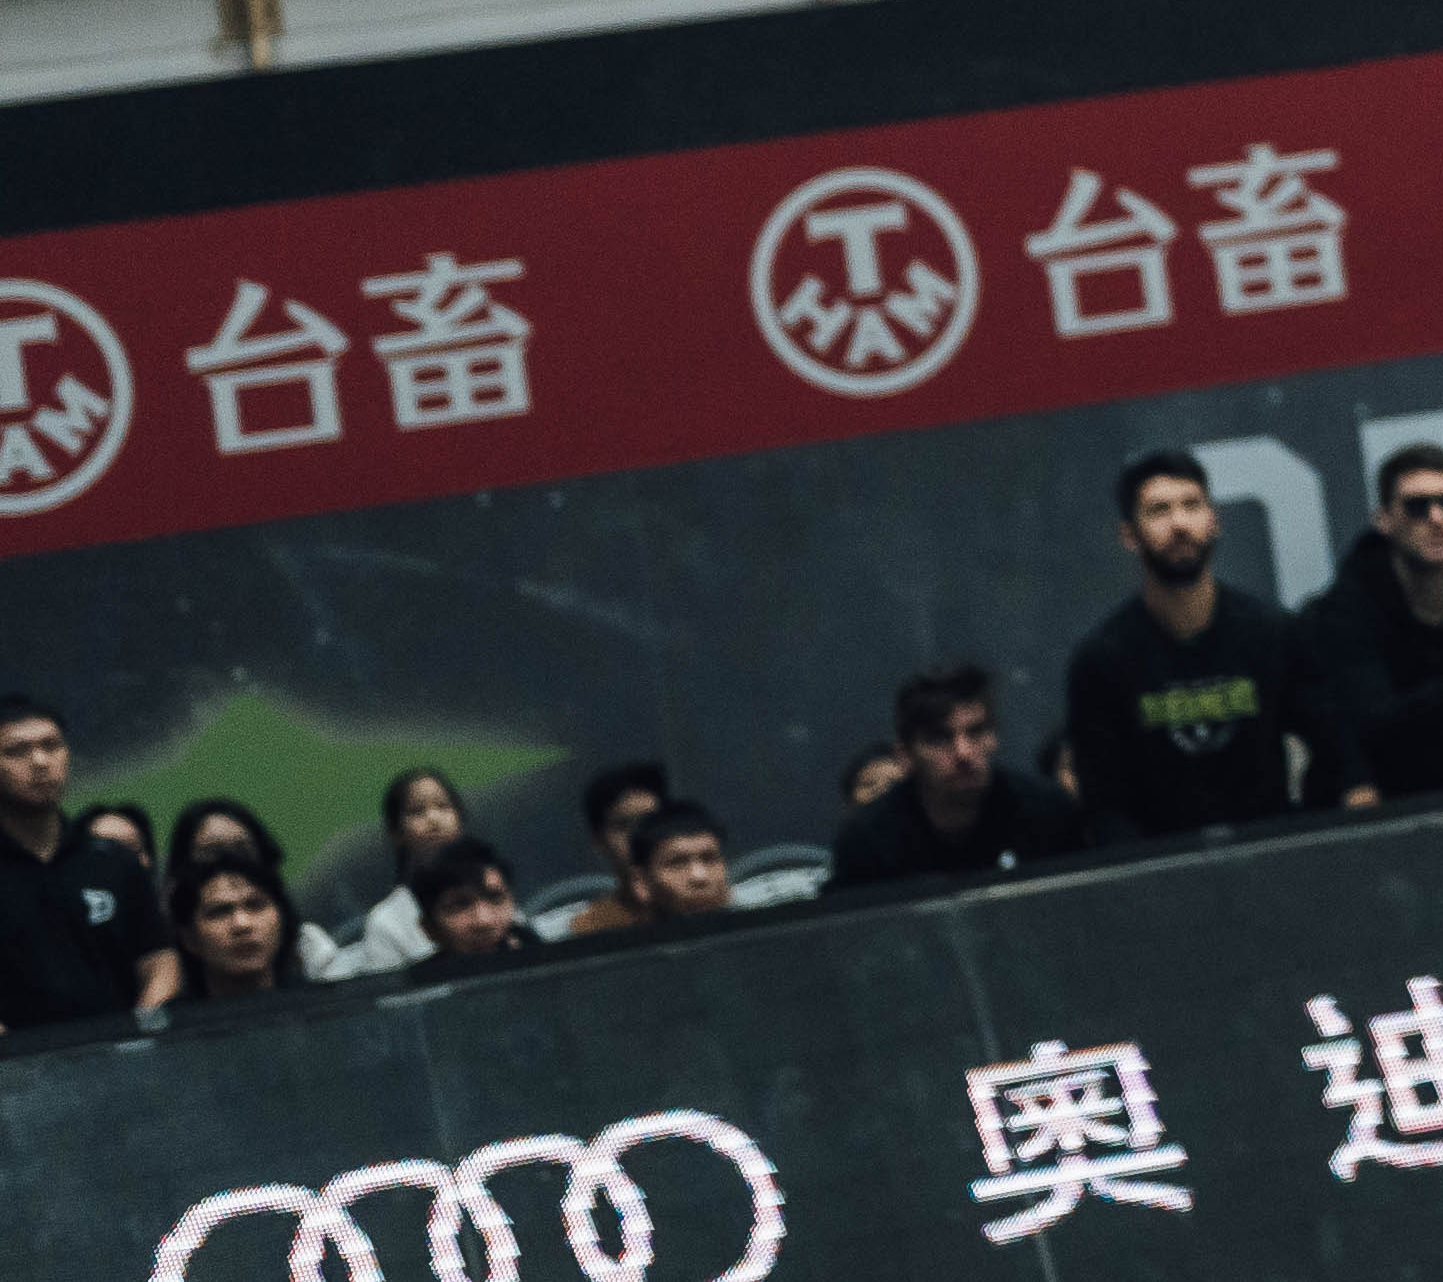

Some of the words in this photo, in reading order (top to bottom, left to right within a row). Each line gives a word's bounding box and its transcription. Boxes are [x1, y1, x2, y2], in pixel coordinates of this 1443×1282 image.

[779, 258, 958, 370] HAM
[1023, 141, 1349, 340] 台畜
[184, 250, 532, 457] 台畜
